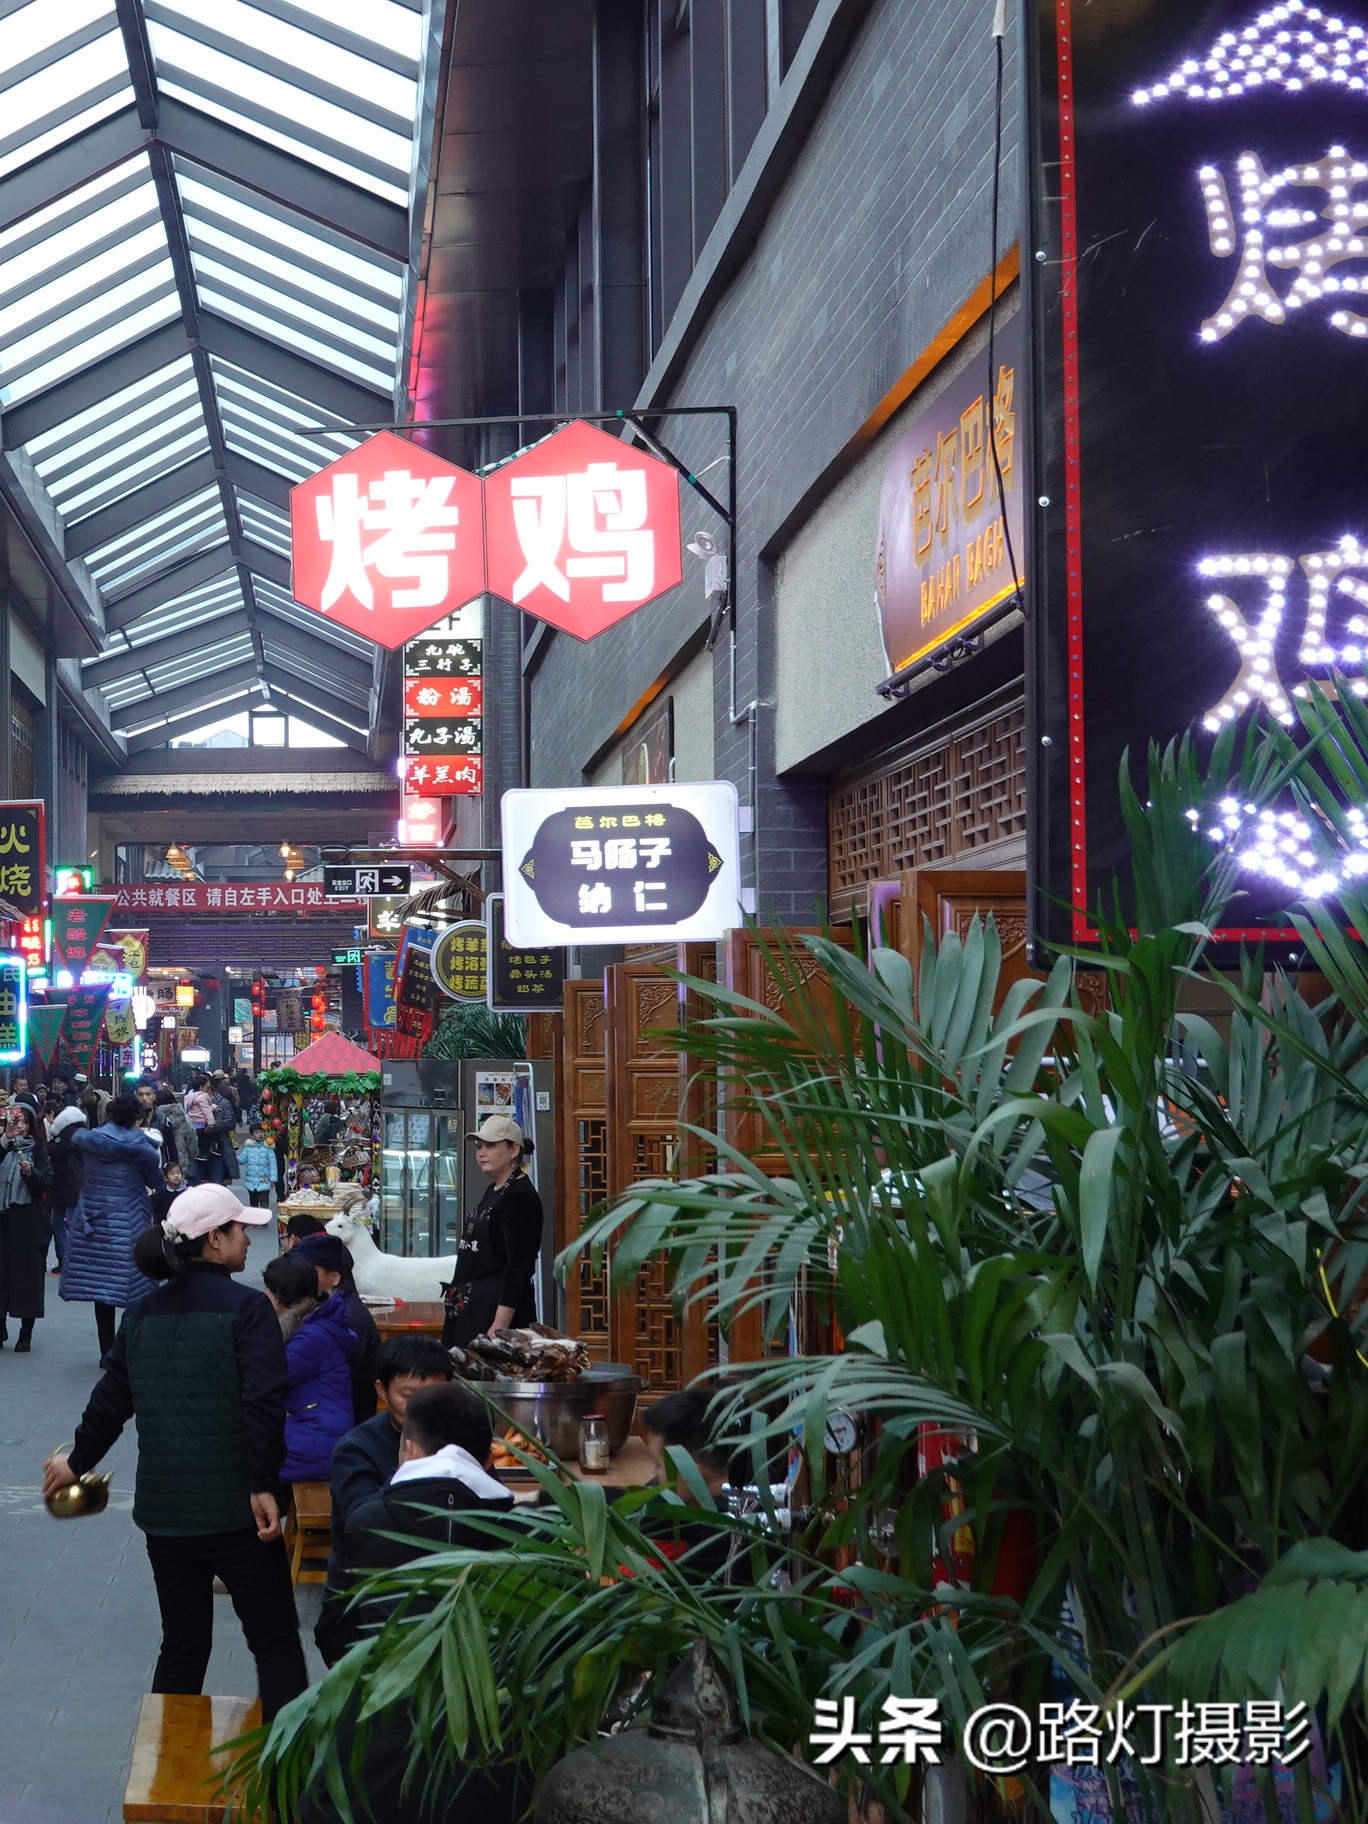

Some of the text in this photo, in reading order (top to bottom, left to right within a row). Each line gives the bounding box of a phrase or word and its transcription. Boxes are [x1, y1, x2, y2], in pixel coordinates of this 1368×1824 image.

[909, 364, 1016, 570] 芭尔巴格
[314, 462, 656, 613] 烤鸡
[920, 514, 1005, 628] BAHAR BAGH
[415, 686, 473, 706] 粉湯
[408, 725, 477, 745] 丸子湯
[408, 765, 477, 785] 羊羔肉
[574, 813, 667, 830] 芭尔巴格
[570, 837, 672, 871] 马肠子
[116, 888, 197, 907] 公共就餐区
[578, 880, 668, 914] 纳仁
[66, 908, 88, 959] 老酸奶
[516, 983, 546, 994] 奶茶
